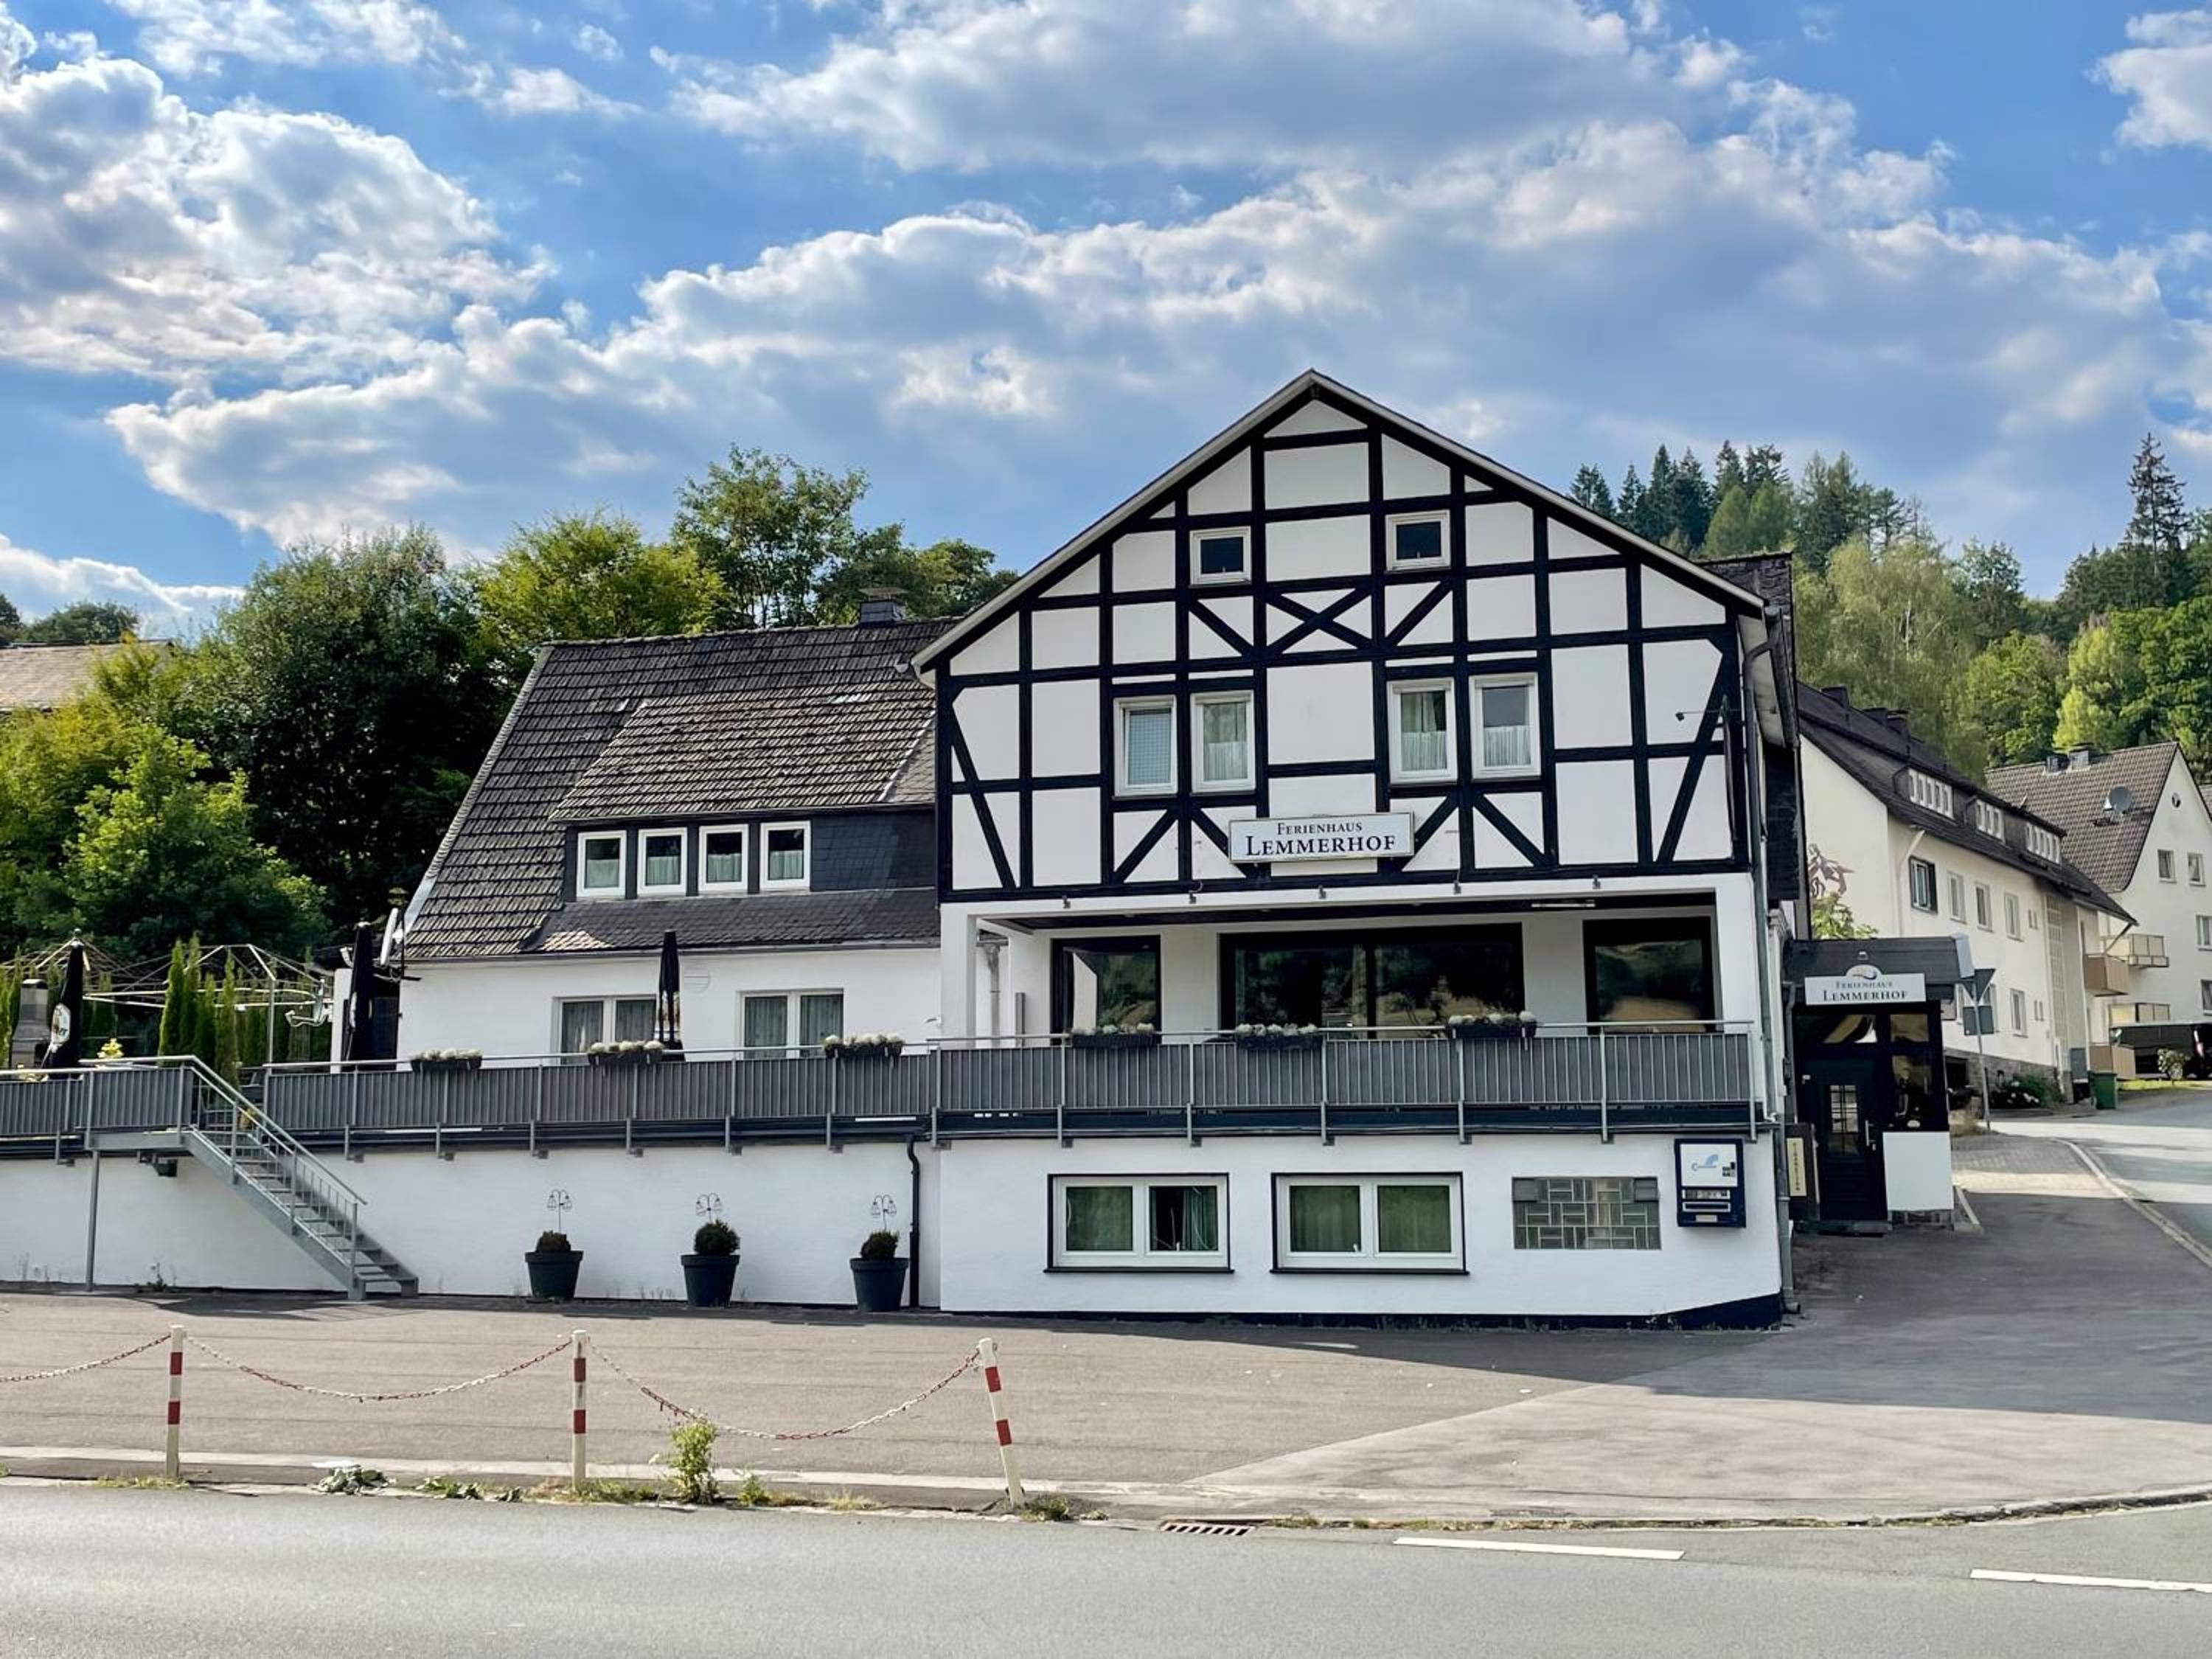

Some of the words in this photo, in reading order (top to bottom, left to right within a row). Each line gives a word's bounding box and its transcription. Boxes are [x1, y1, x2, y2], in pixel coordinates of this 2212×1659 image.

[1277, 821, 1363, 835] FERIENHAUS
[1245, 835, 1396, 856] LEMMERHOF
[1823, 990, 1908, 1002] LEMMERHOF
